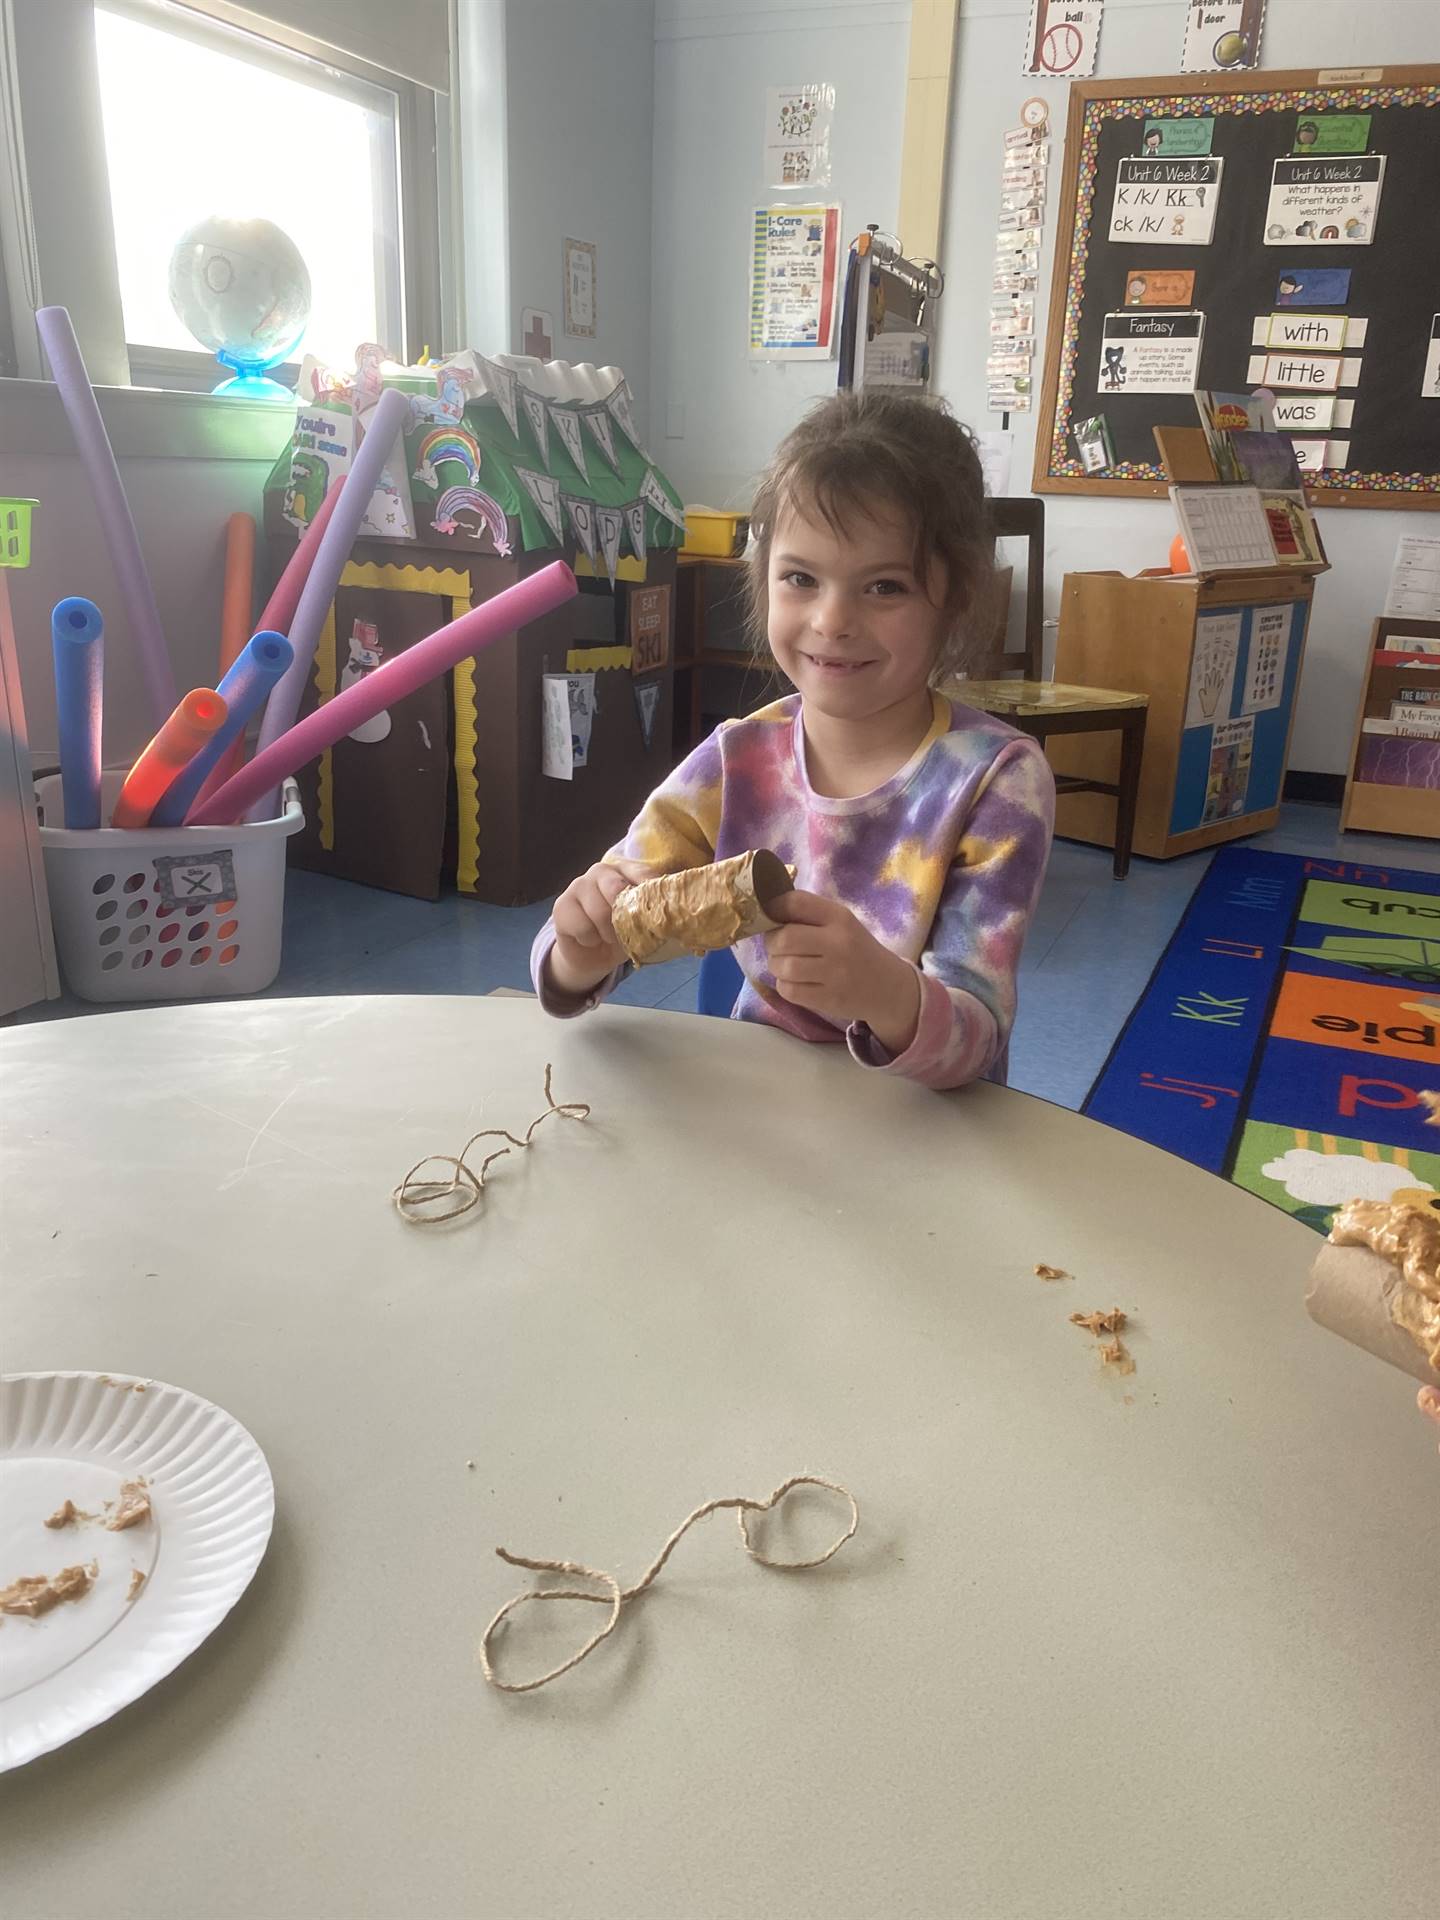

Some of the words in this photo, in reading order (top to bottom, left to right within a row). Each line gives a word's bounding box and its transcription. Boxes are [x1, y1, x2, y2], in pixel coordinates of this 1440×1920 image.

[1065, 11, 1083, 22] ball
[1204, 13, 1226, 24] door
[1128, 165, 1152, 181] Unit
[1153, 166, 1162, 181] 6
[1166, 165, 1198, 181] Week
[1200, 165, 1210, 181] 2
[1291, 167, 1312, 181] Unit
[1314, 168, 1321, 181] 6
[1324, 166, 1352, 181] Week
[1354, 165, 1362, 180] 2
[1118, 188, 1130, 204] K
[1134, 188, 1160, 205] /k/
[1166, 188, 1188, 207] Kk
[1288, 186, 1311, 195] What
[1314, 185, 1351, 196] happens
[1353, 184, 1361, 192] in
[1282, 196, 1324, 206] different
[1326, 196, 1349, 205] kinds
[1351, 195, 1363, 203] of
[1300, 207, 1343, 216] weather?
[768, 227, 797, 238] Rules
[1113, 216, 1134, 232] ck
[1138, 216, 1164, 233] /k/
[1129, 318, 1175, 336] Fantasy
[1284, 322, 1329, 342] with
[1277, 361, 1326, 383] little
[1276, 405, 1316, 420] was
[641, 595, 658, 611] EAT
[638, 614, 660, 631] SLEEP
[637, 632, 662, 667] SKI
[1401, 690, 1415, 700] THE
[1400, 709, 1417, 720] My
[1311, 1014, 1436, 1047] pie
